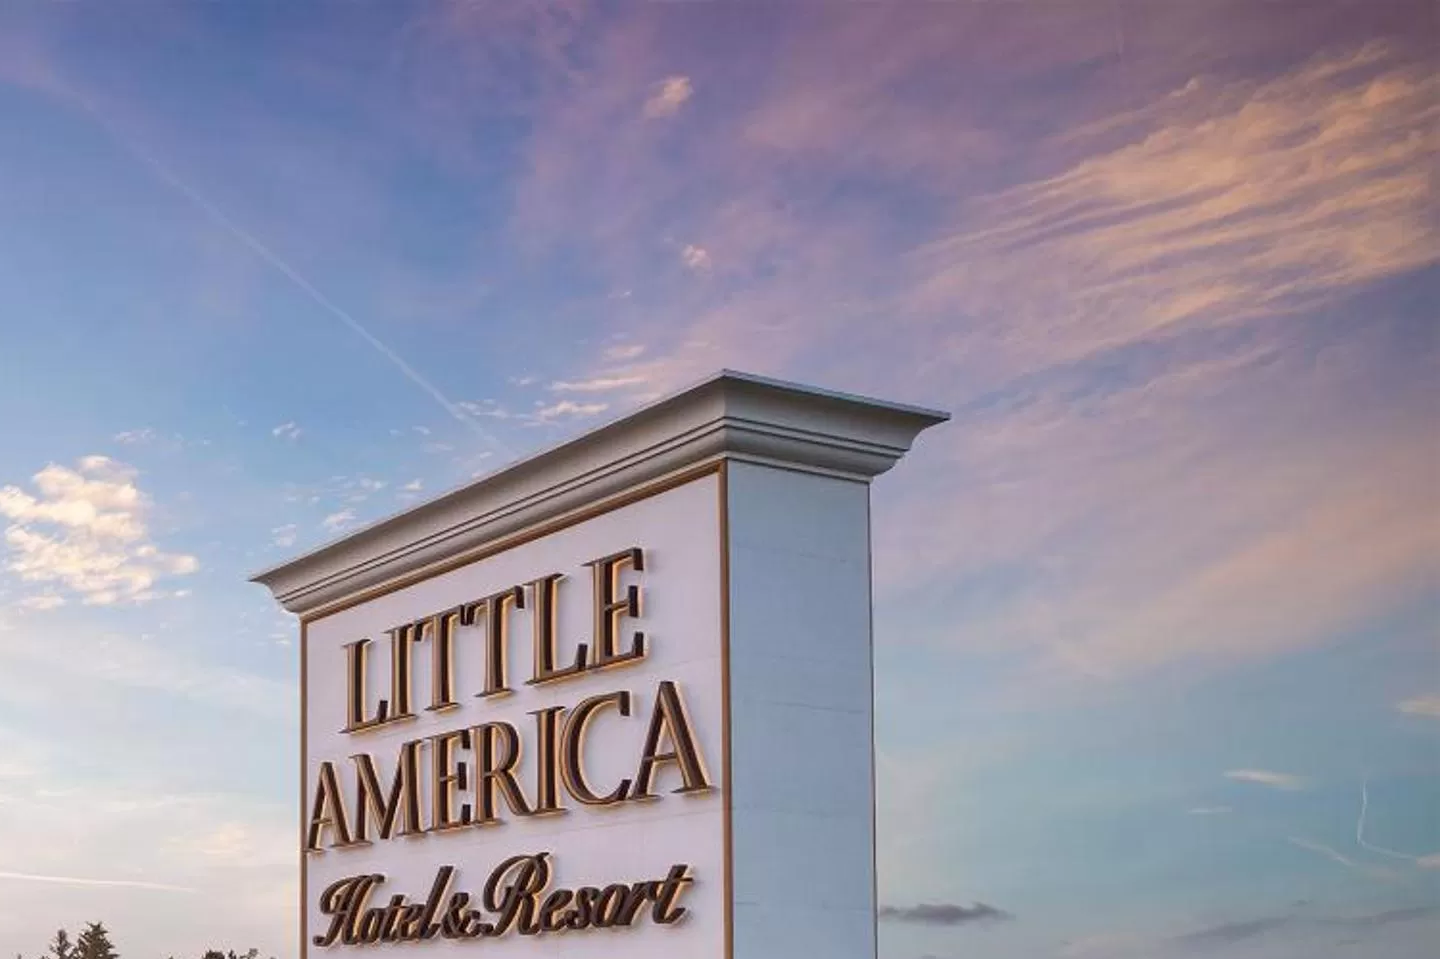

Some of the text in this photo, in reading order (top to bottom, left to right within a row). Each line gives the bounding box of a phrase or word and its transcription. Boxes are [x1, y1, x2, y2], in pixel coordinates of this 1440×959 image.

[341, 547, 646, 734] LITTLE
[304, 680, 716, 852] AMERICA
[313, 864, 454, 948] Hotel
[474, 851, 695, 938] Resort
